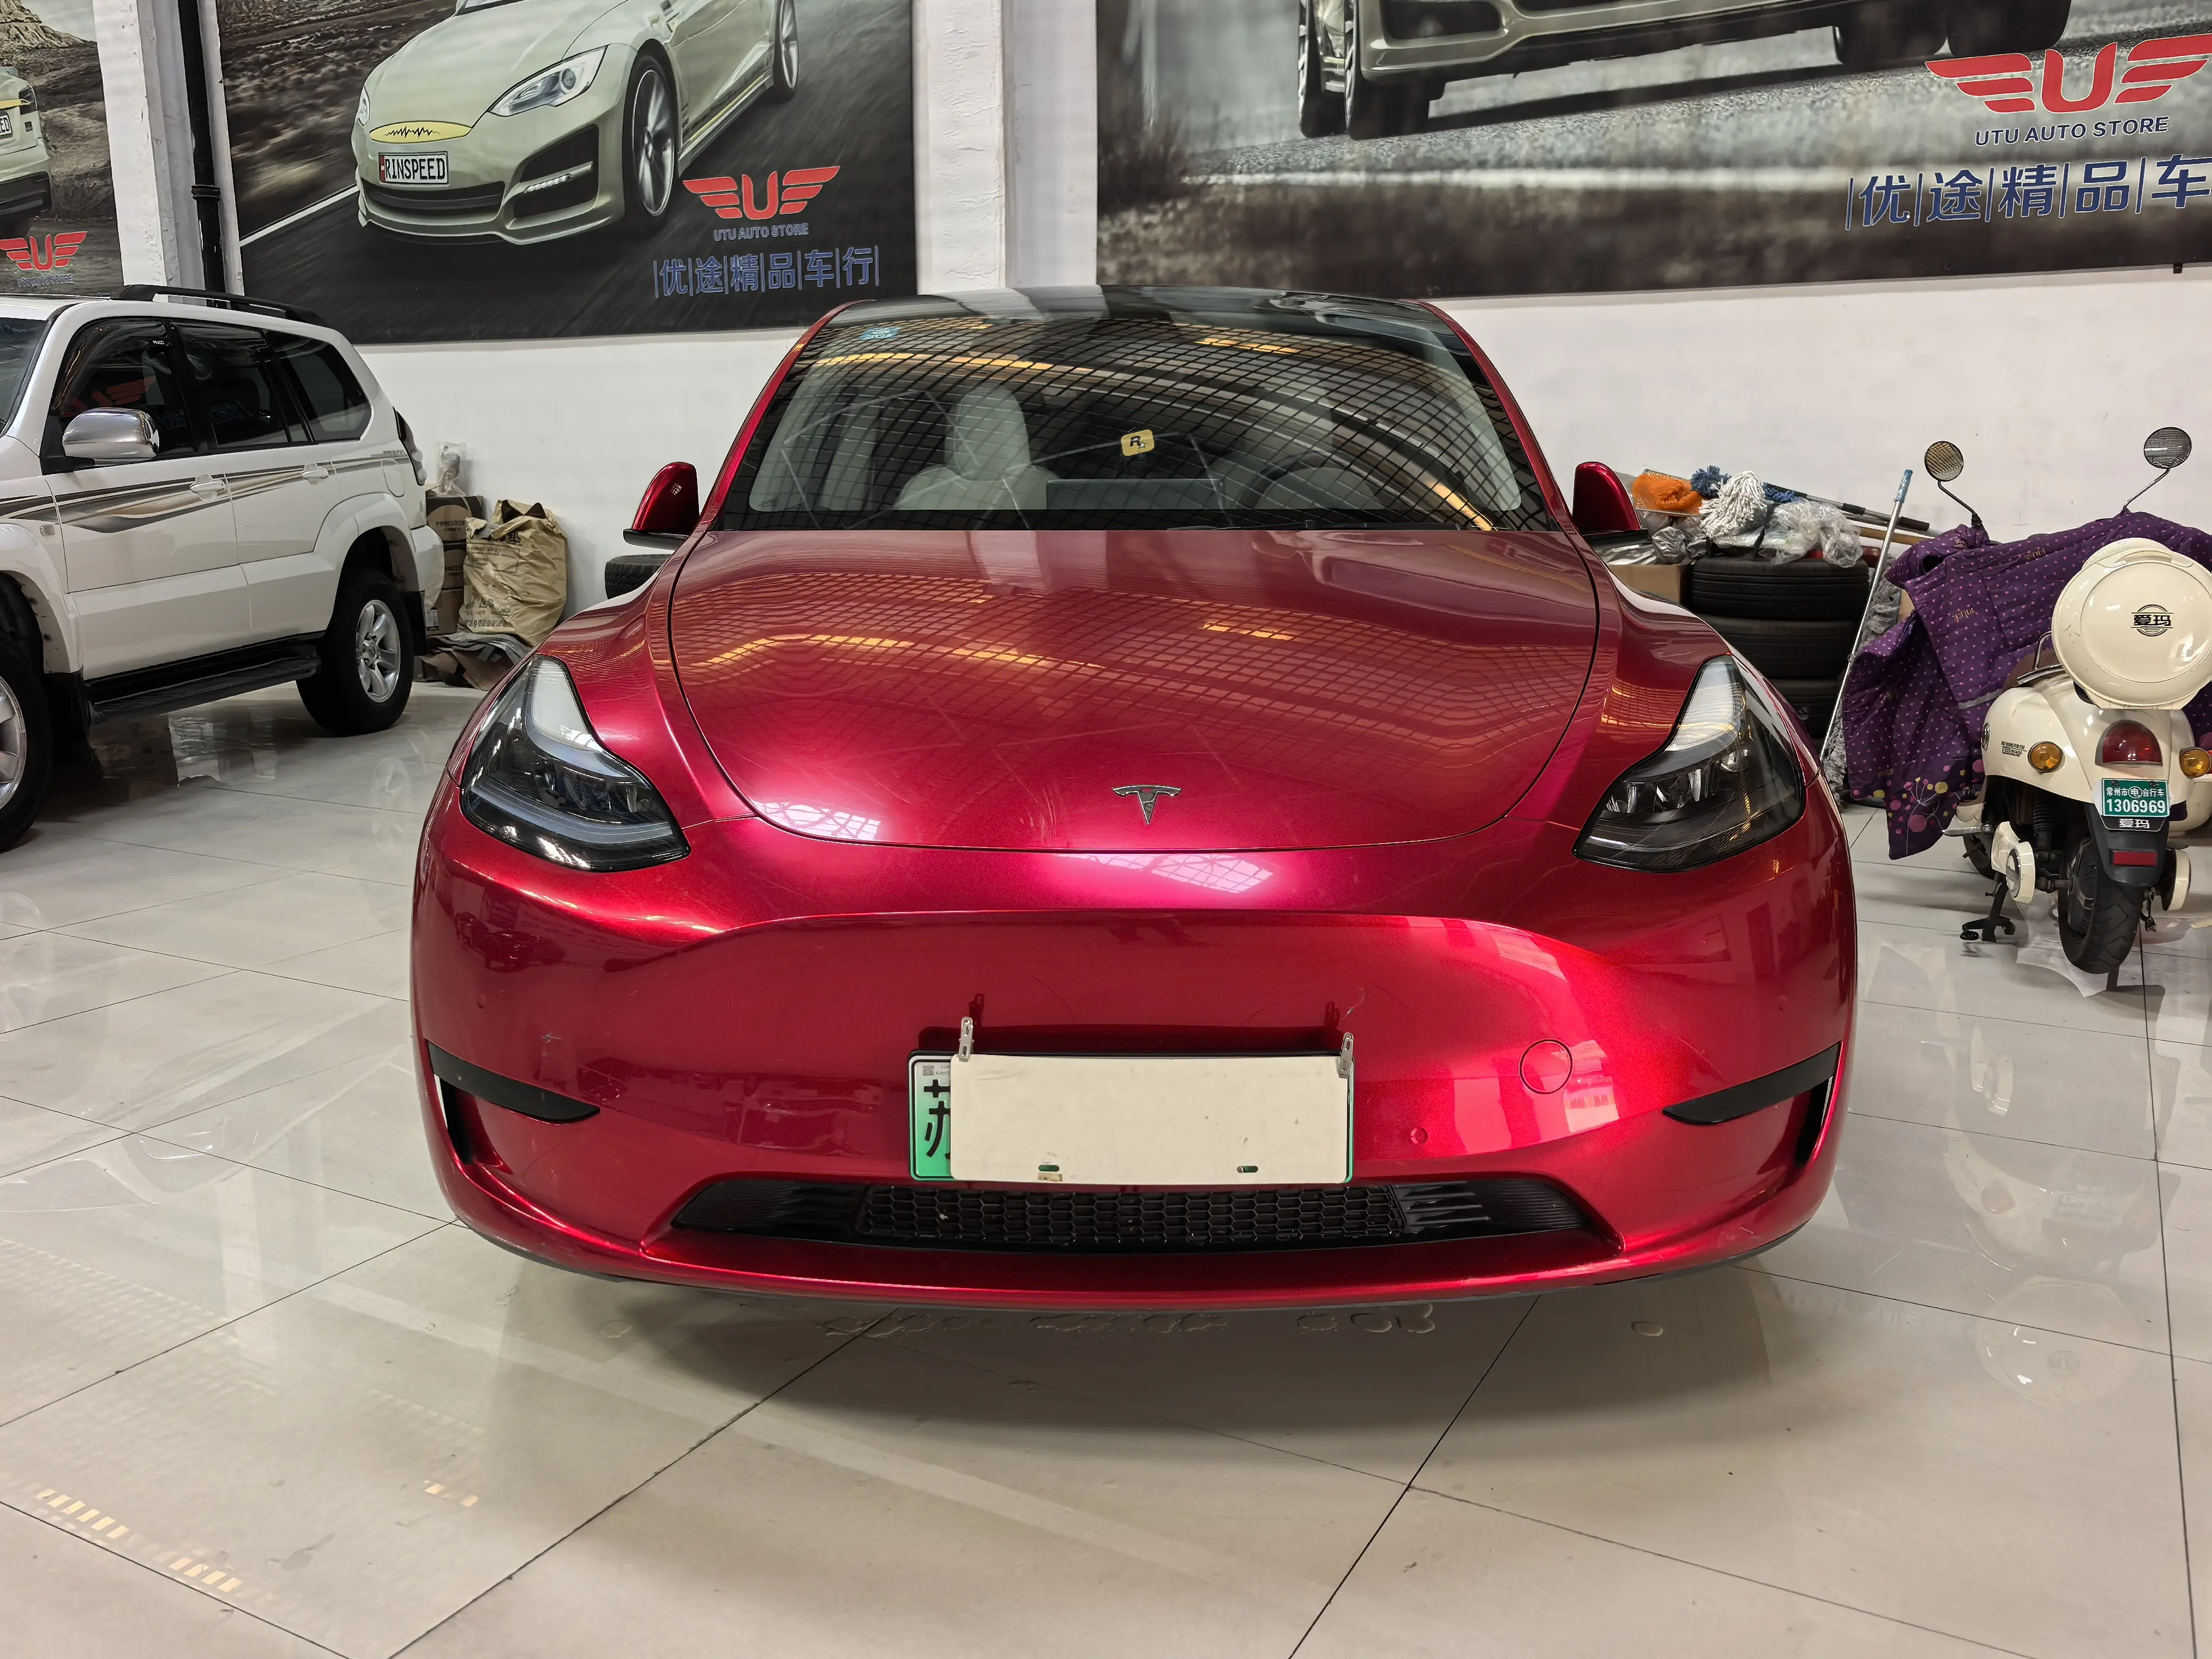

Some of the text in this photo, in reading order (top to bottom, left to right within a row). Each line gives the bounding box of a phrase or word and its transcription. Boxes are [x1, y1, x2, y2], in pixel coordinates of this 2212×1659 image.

[1975, 116, 2170, 146] UTU AUTO STORE
[385, 158, 446, 180] RINSPEED
[713, 222, 809, 241] UTU AUTO STORE
[2134, 614, 2171, 626] 爱玛
[2106, 798, 2166, 813] 1306969
[2119, 818, 2150, 828] 爱玛
